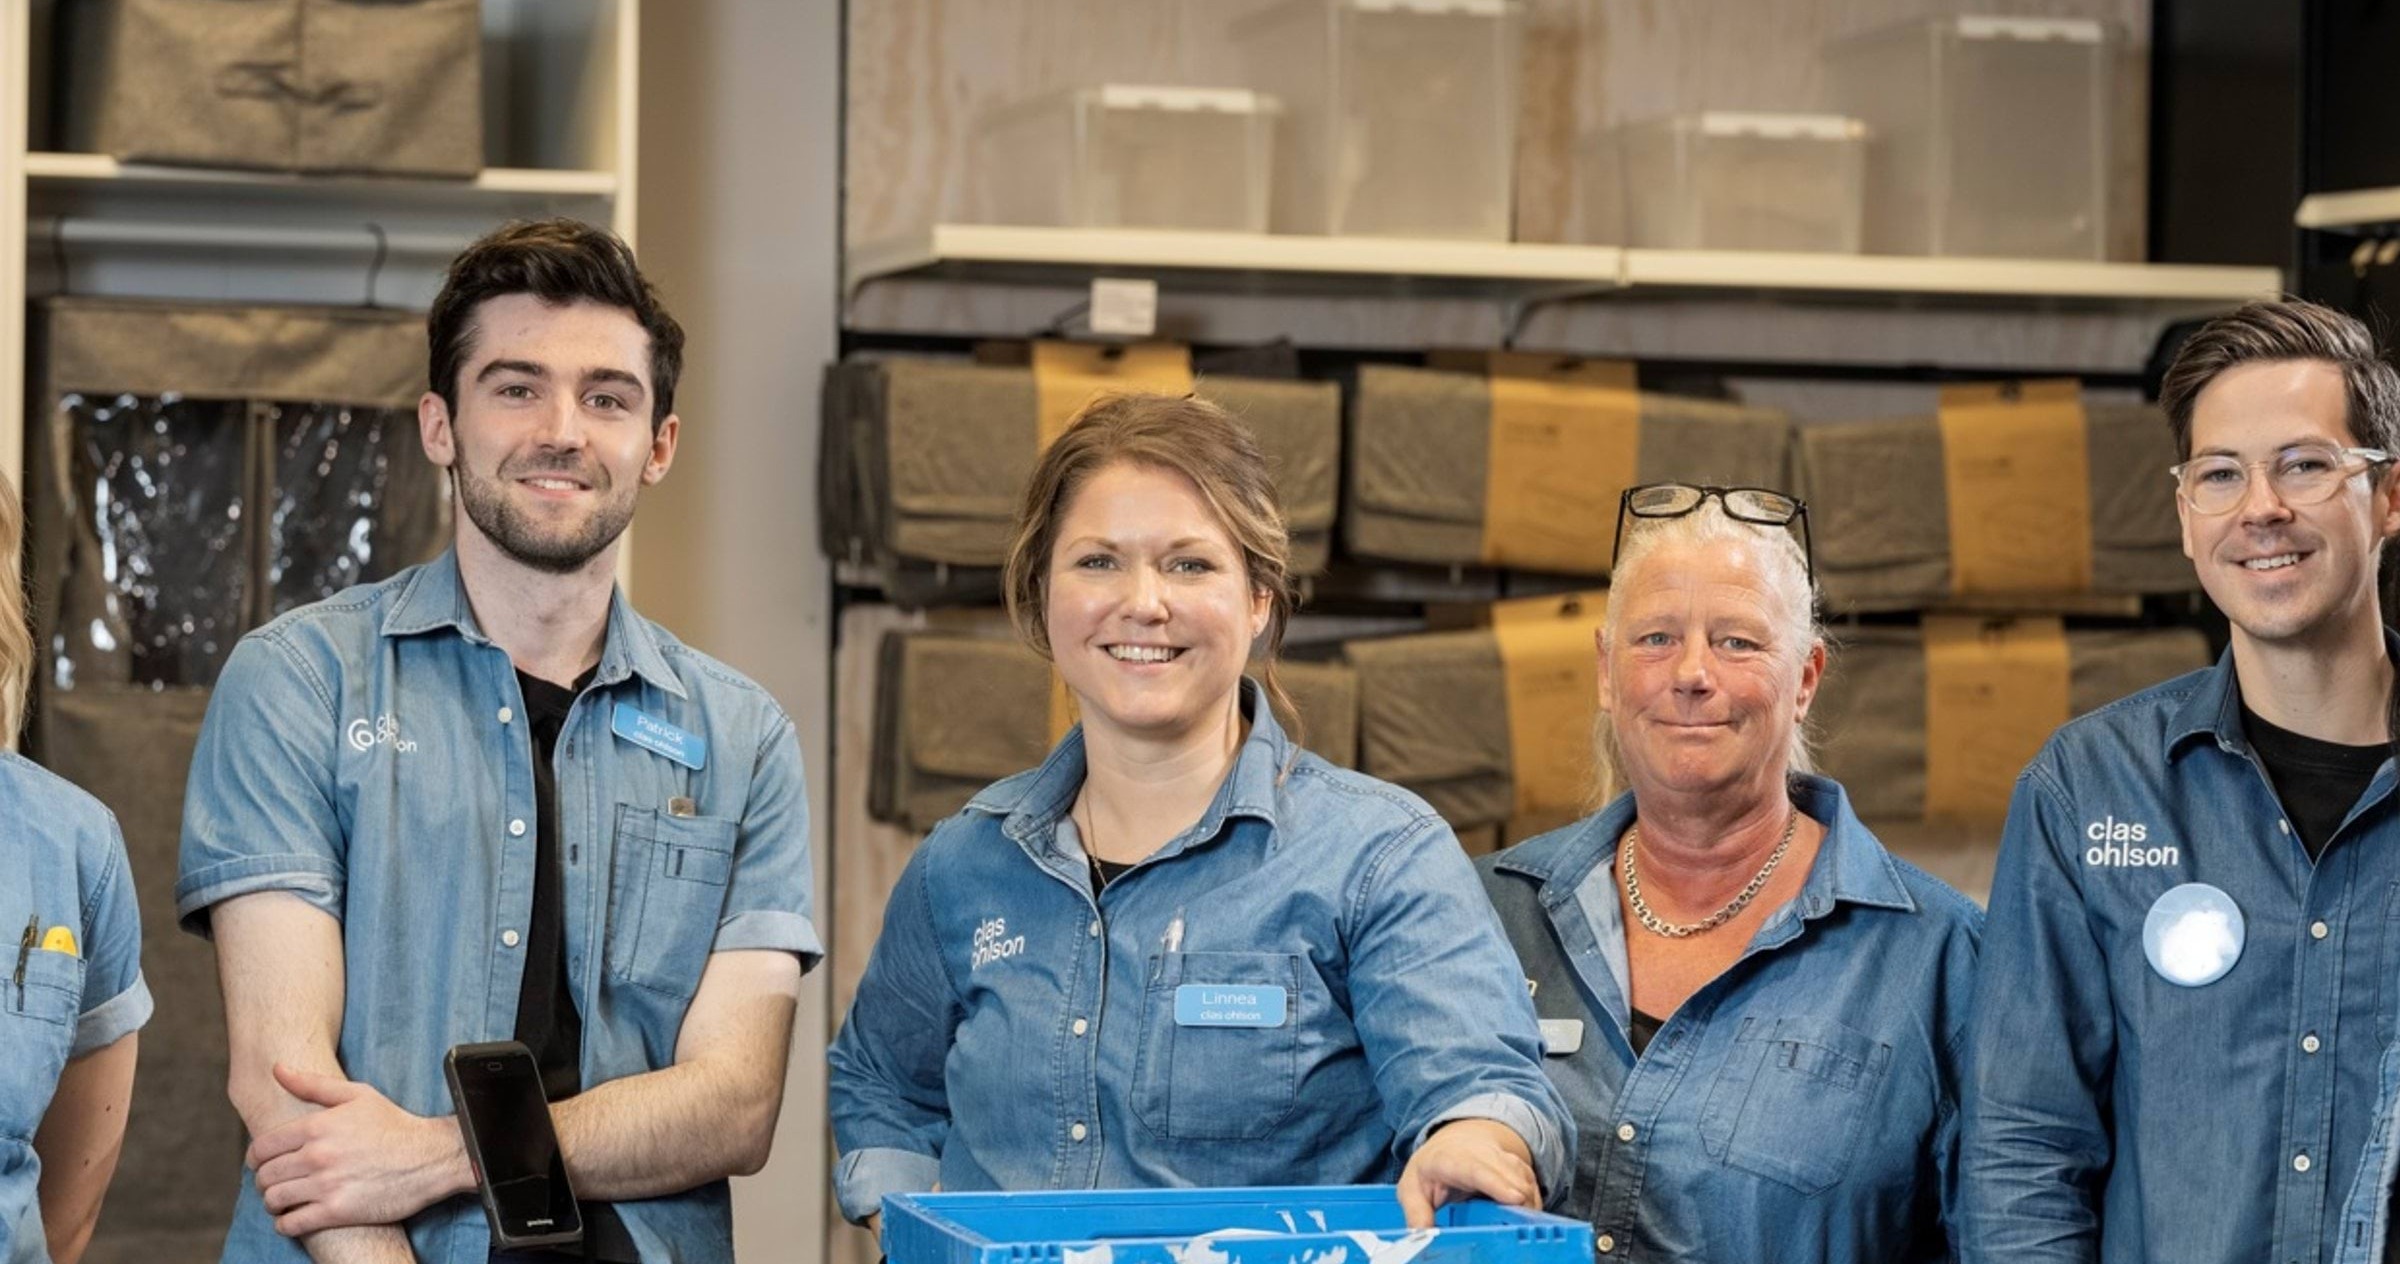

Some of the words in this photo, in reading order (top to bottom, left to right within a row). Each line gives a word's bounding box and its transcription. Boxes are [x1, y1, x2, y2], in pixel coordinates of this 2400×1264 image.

[636, 714, 684, 745] Patrick
[2087, 815, 2147, 842] clas
[2086, 842, 2179, 867] ohlson
[974, 917, 1006, 947] clas
[1202, 991, 1257, 1005] Linnea
[1200, 1009, 1223, 1020] clas
[1224, 1010, 1262, 1020] ohlson
